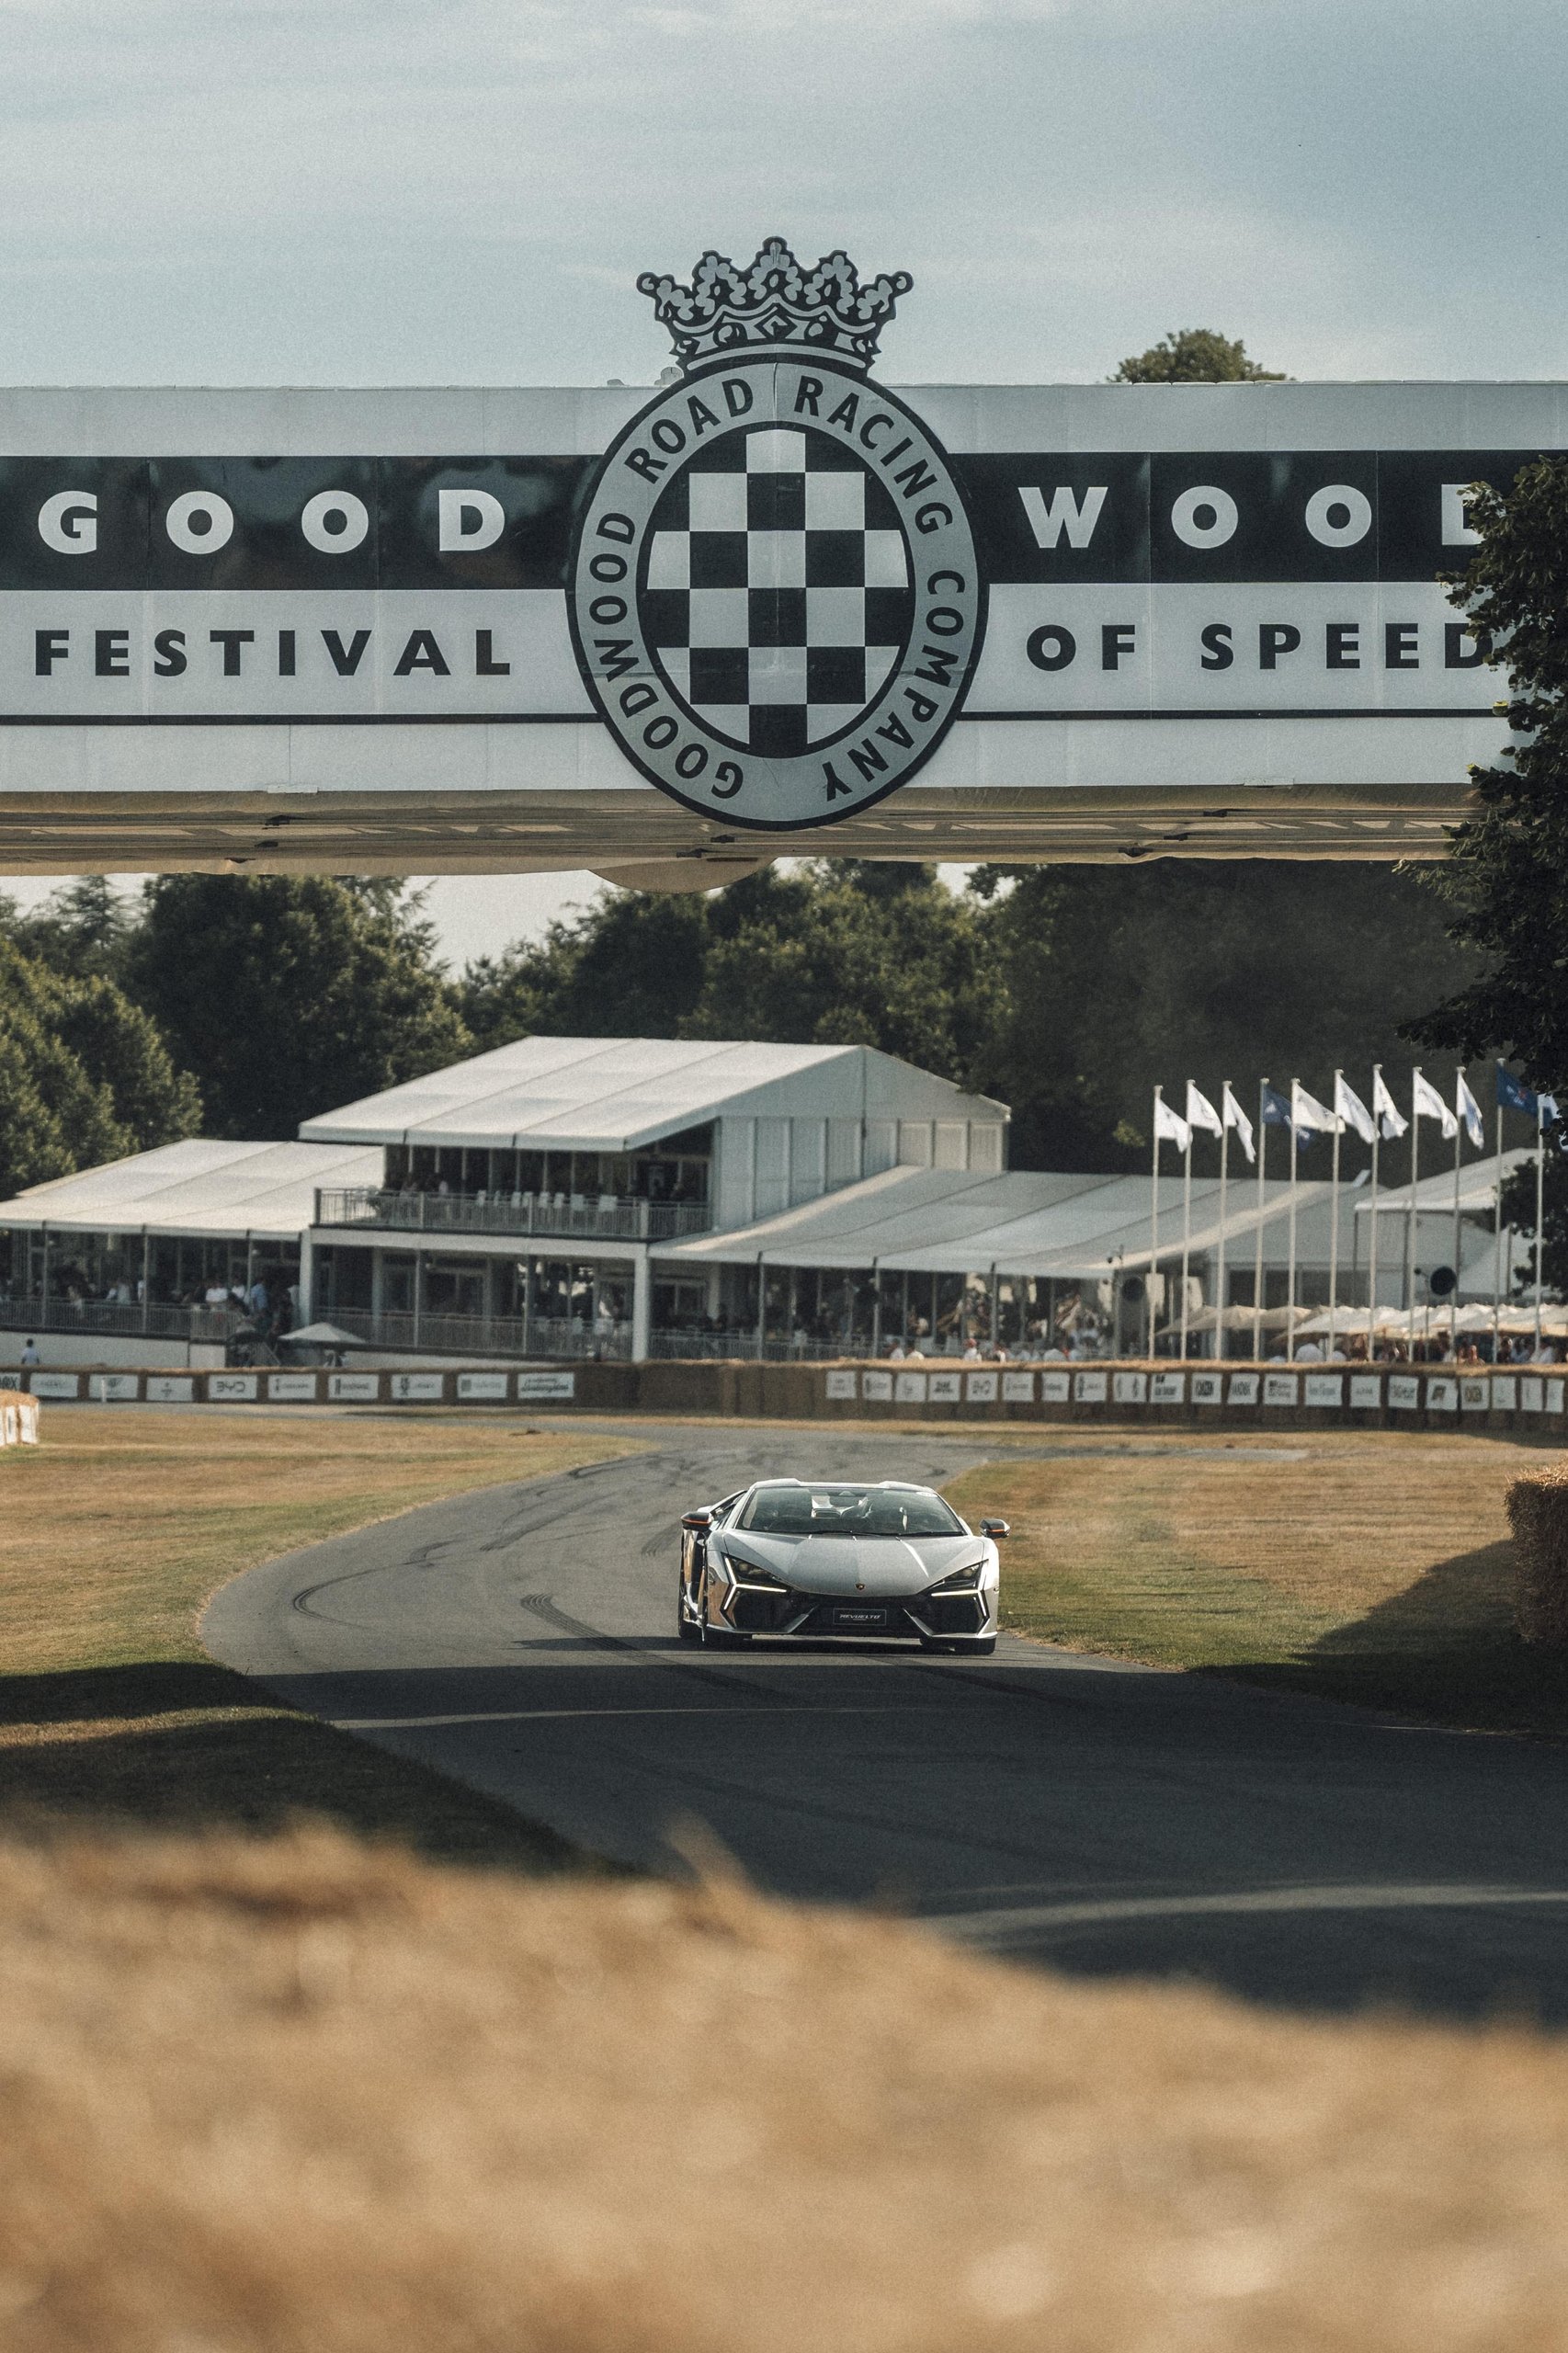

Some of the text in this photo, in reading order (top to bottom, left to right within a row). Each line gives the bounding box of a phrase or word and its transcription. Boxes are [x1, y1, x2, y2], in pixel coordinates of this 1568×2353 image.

[38, 489, 506, 554] GOOD
[588, 375, 965, 801] GOODWOOD ROAD RACING COMPANY
[35, 623, 1494, 676] FESTIVAL OF SPEED
[216, 1381, 245, 1392] BYD
